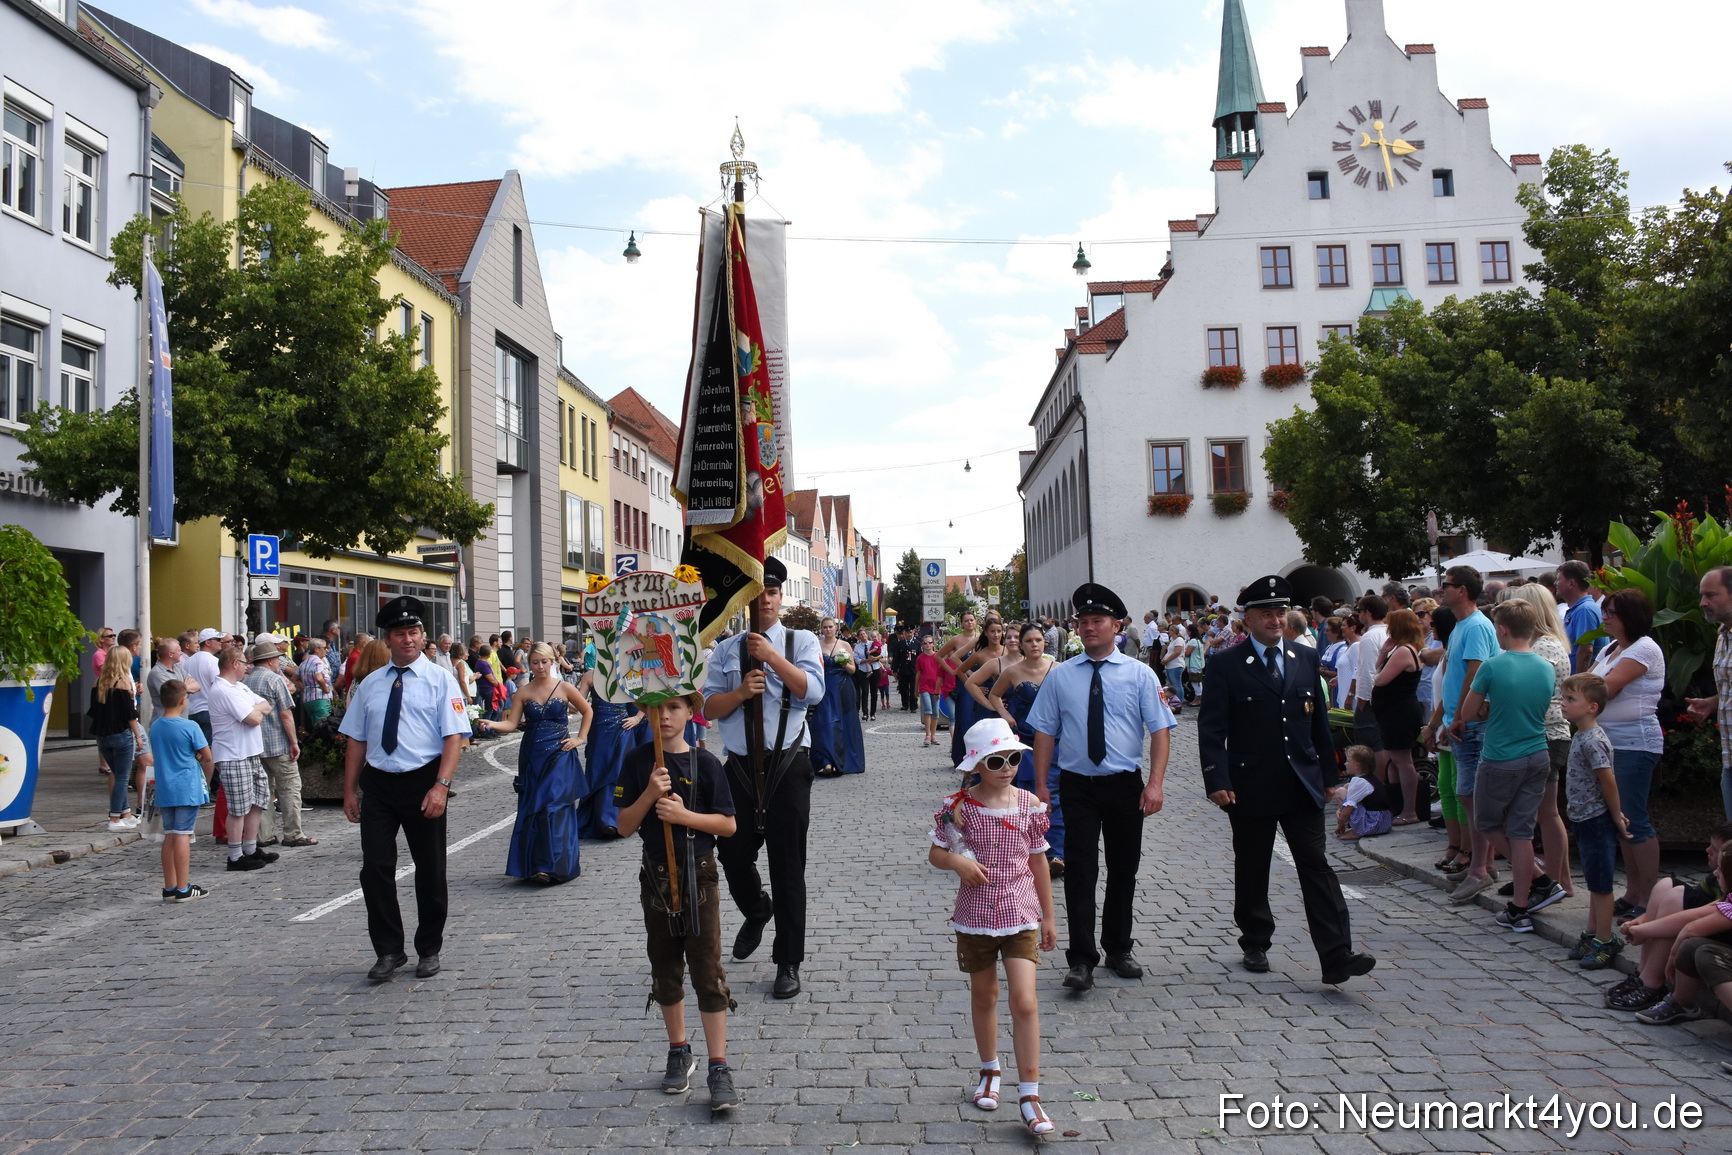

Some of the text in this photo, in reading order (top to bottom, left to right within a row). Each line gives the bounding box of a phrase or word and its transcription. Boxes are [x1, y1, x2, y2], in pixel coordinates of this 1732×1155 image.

[712, 403, 731, 414] toten
[694, 440, 734, 451] Kameraden
[691, 478, 734, 490] Oberweiling
[256, 540, 273, 570] P
